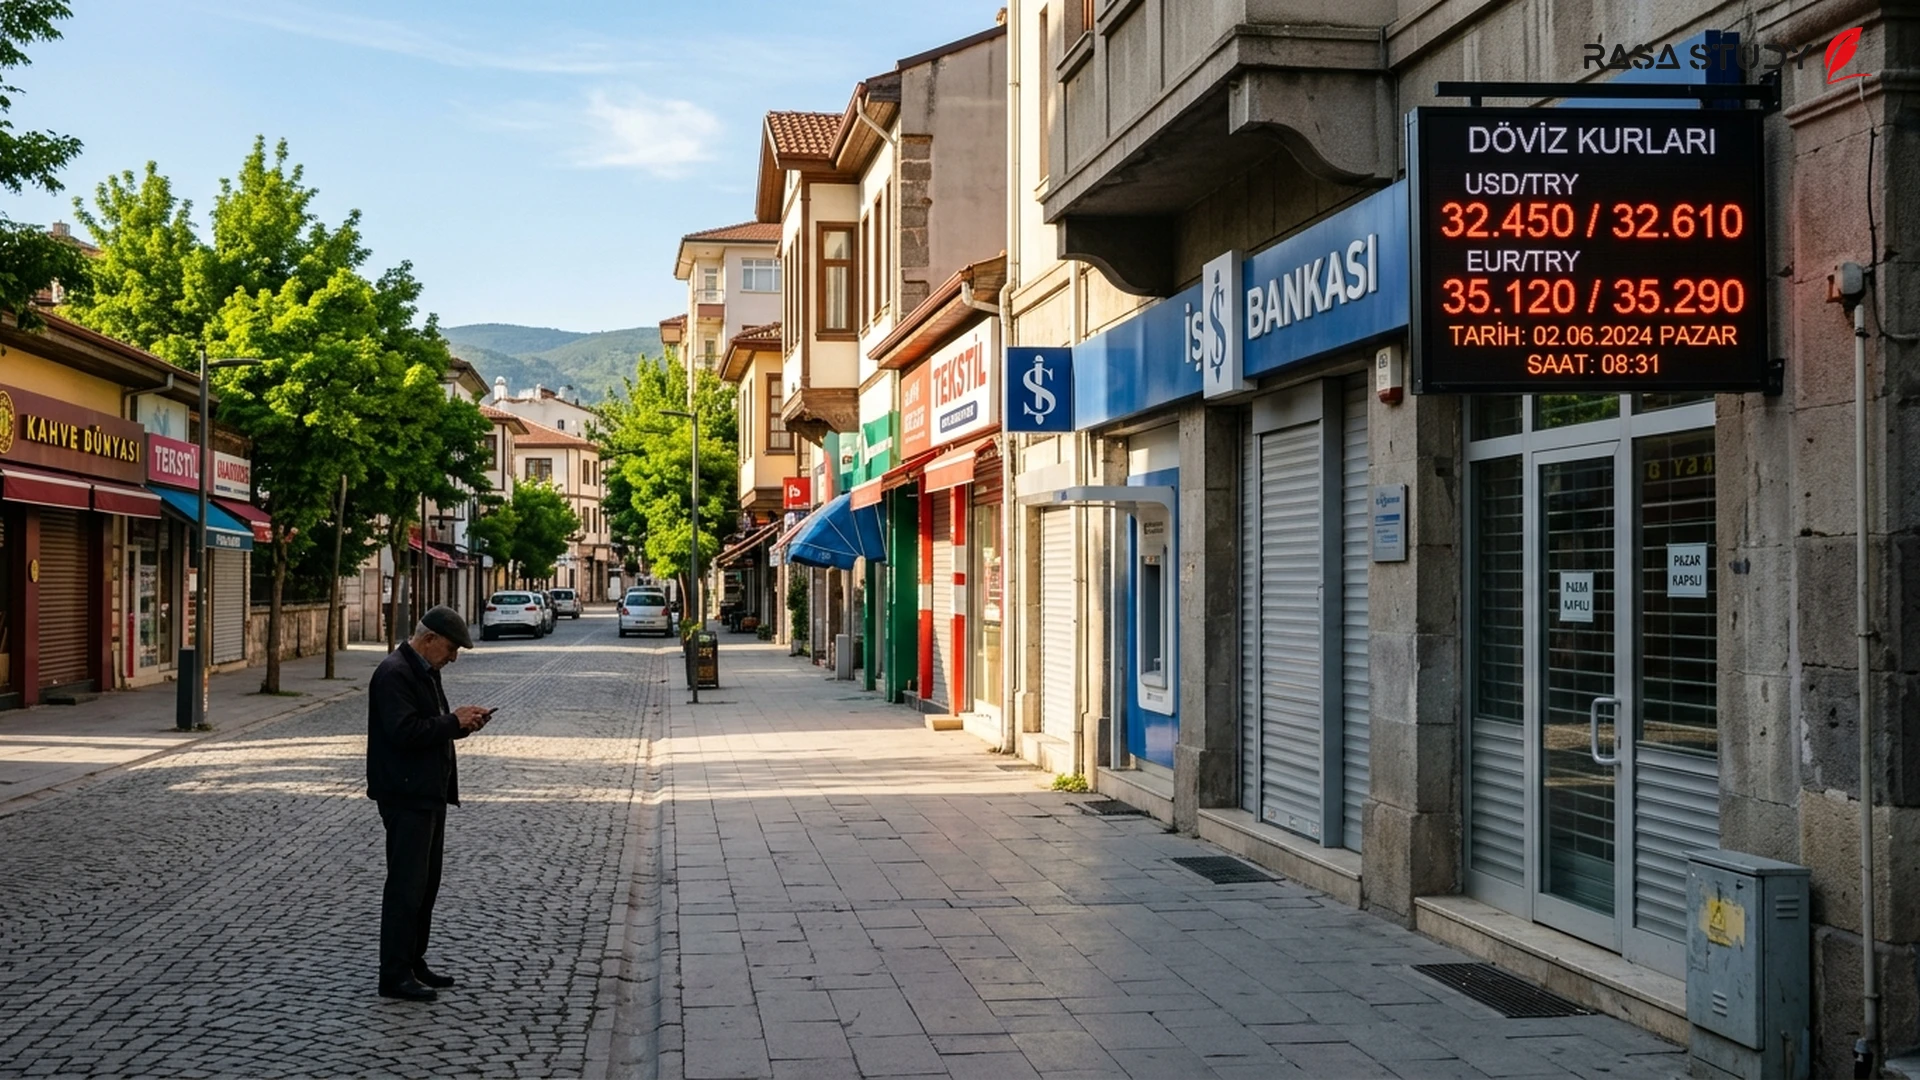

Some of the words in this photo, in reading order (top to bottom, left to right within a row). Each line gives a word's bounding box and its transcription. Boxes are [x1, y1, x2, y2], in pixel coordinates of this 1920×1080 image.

[1468, 121, 1568, 154] DÖVİZ
[1578, 127, 1716, 155] KURLARI
[1465, 173, 1579, 195] USD/TRY
[1441, 202, 1575, 238] 32.450
[1586, 203, 1600, 238] /
[1612, 202, 1743, 238] 32.610
[1467, 250, 1581, 273] EUR/TRY
[1247, 234, 1379, 341] BANKASI
[1442, 279, 1576, 315] 35.120
[1587, 279, 1602, 314] /
[1613, 279, 1745, 315] 35.290
[1449, 321, 1527, 346] TARİH:
[1533, 325, 1653, 346] 02.06.2024
[1660, 325, 1738, 346] PAZAR
[933, 333, 986, 409] TEKSTİL
[1527, 354, 1595, 375] SAAT:
[1601, 354, 1659, 375] 08:31
[27, 414, 78, 450] KAHVE
[1673, 554, 1702, 567] PAZAR
